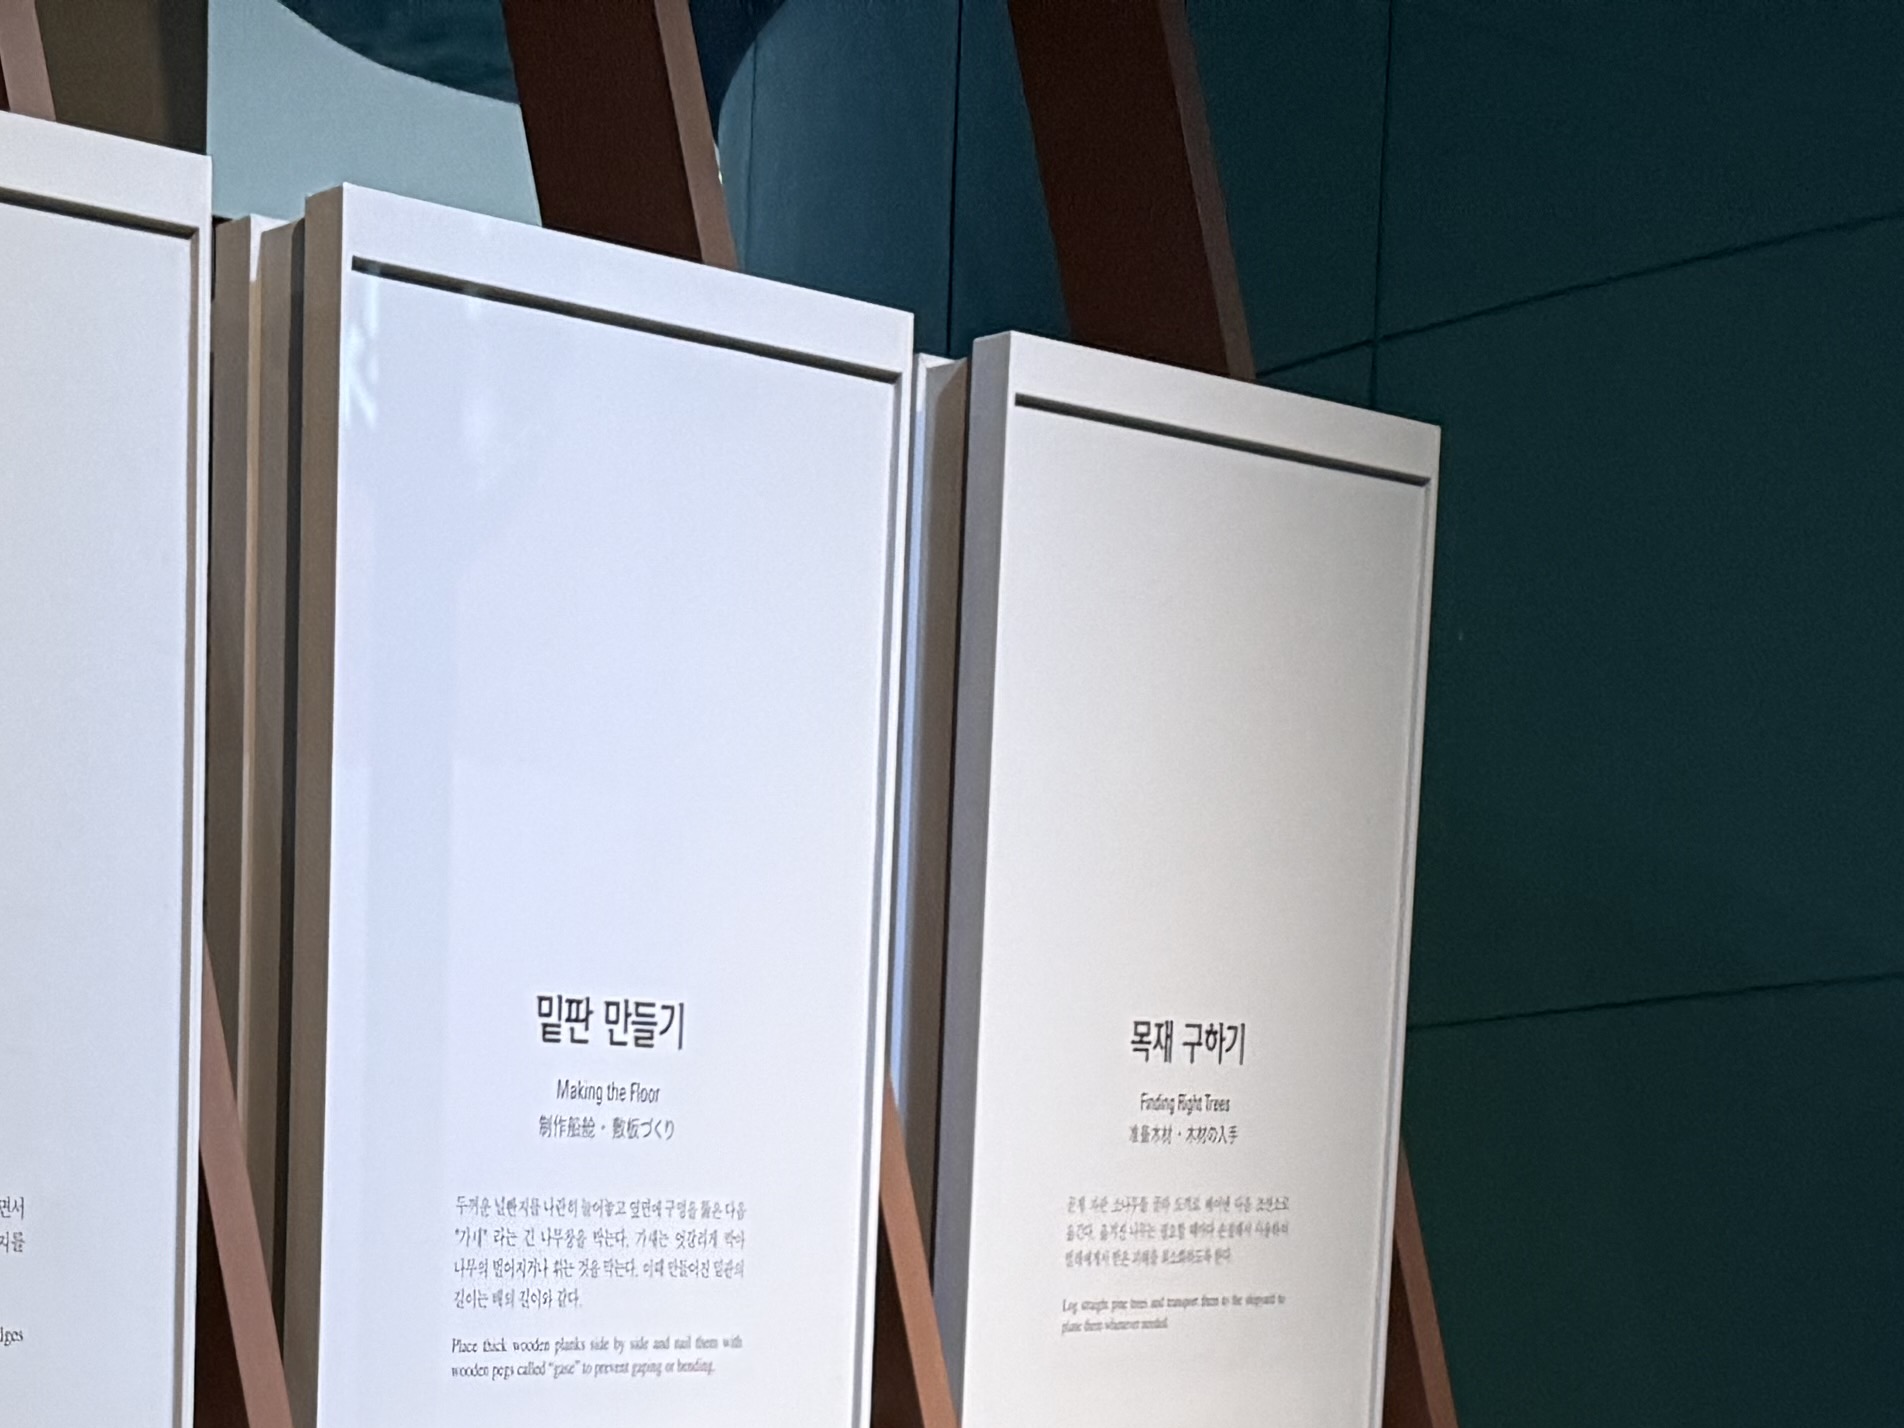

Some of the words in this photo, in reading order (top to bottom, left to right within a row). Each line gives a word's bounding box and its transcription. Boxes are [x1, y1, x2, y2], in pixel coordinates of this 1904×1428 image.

[536, 994, 595, 1045] 밑판
[603, 998, 685, 1051] 만들기
[1130, 1019, 1174, 1064] 목재
[1181, 1021, 1246, 1066] 구하기
[556, 1078, 603, 1107] Making
[606, 1080, 627, 1103] the
[629, 1081, 661, 1104] Floor
[1203, 1093, 1231, 1113] Trees
